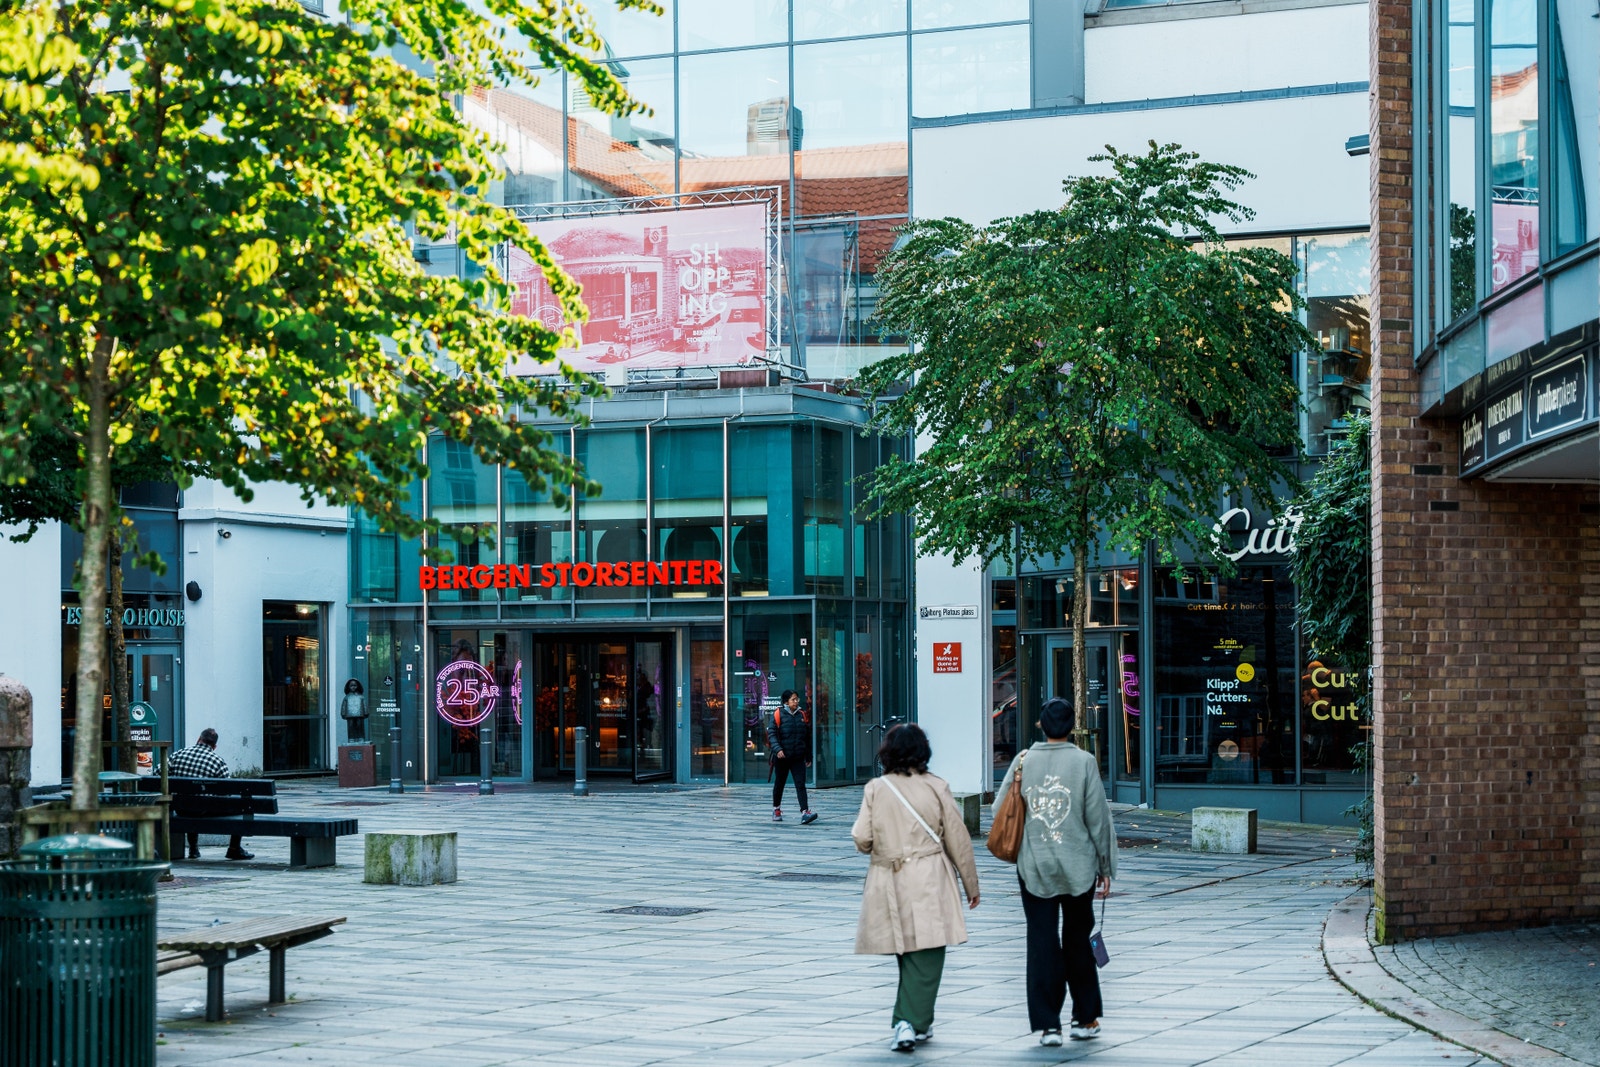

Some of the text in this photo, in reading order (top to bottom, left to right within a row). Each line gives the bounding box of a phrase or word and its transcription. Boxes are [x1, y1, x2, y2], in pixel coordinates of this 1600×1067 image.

[690, 242, 720, 265] SH
[681, 266, 731, 291] OPP
[679, 291, 728, 317] ING
[1537, 378, 1577, 423] jordbærpikene
[419, 560, 723, 589] BERGEN STORSENTER
[138, 608, 185, 626] HOUSE
[961, 608, 974, 616] plass
[446, 678, 500, 705] 25 ÅR
[1207, 678, 1240, 691] Klipp?
[1206, 692, 1251, 702] Cutters.
[1207, 704, 1226, 715] Nå.
[1312, 700, 1358, 720] Cut
